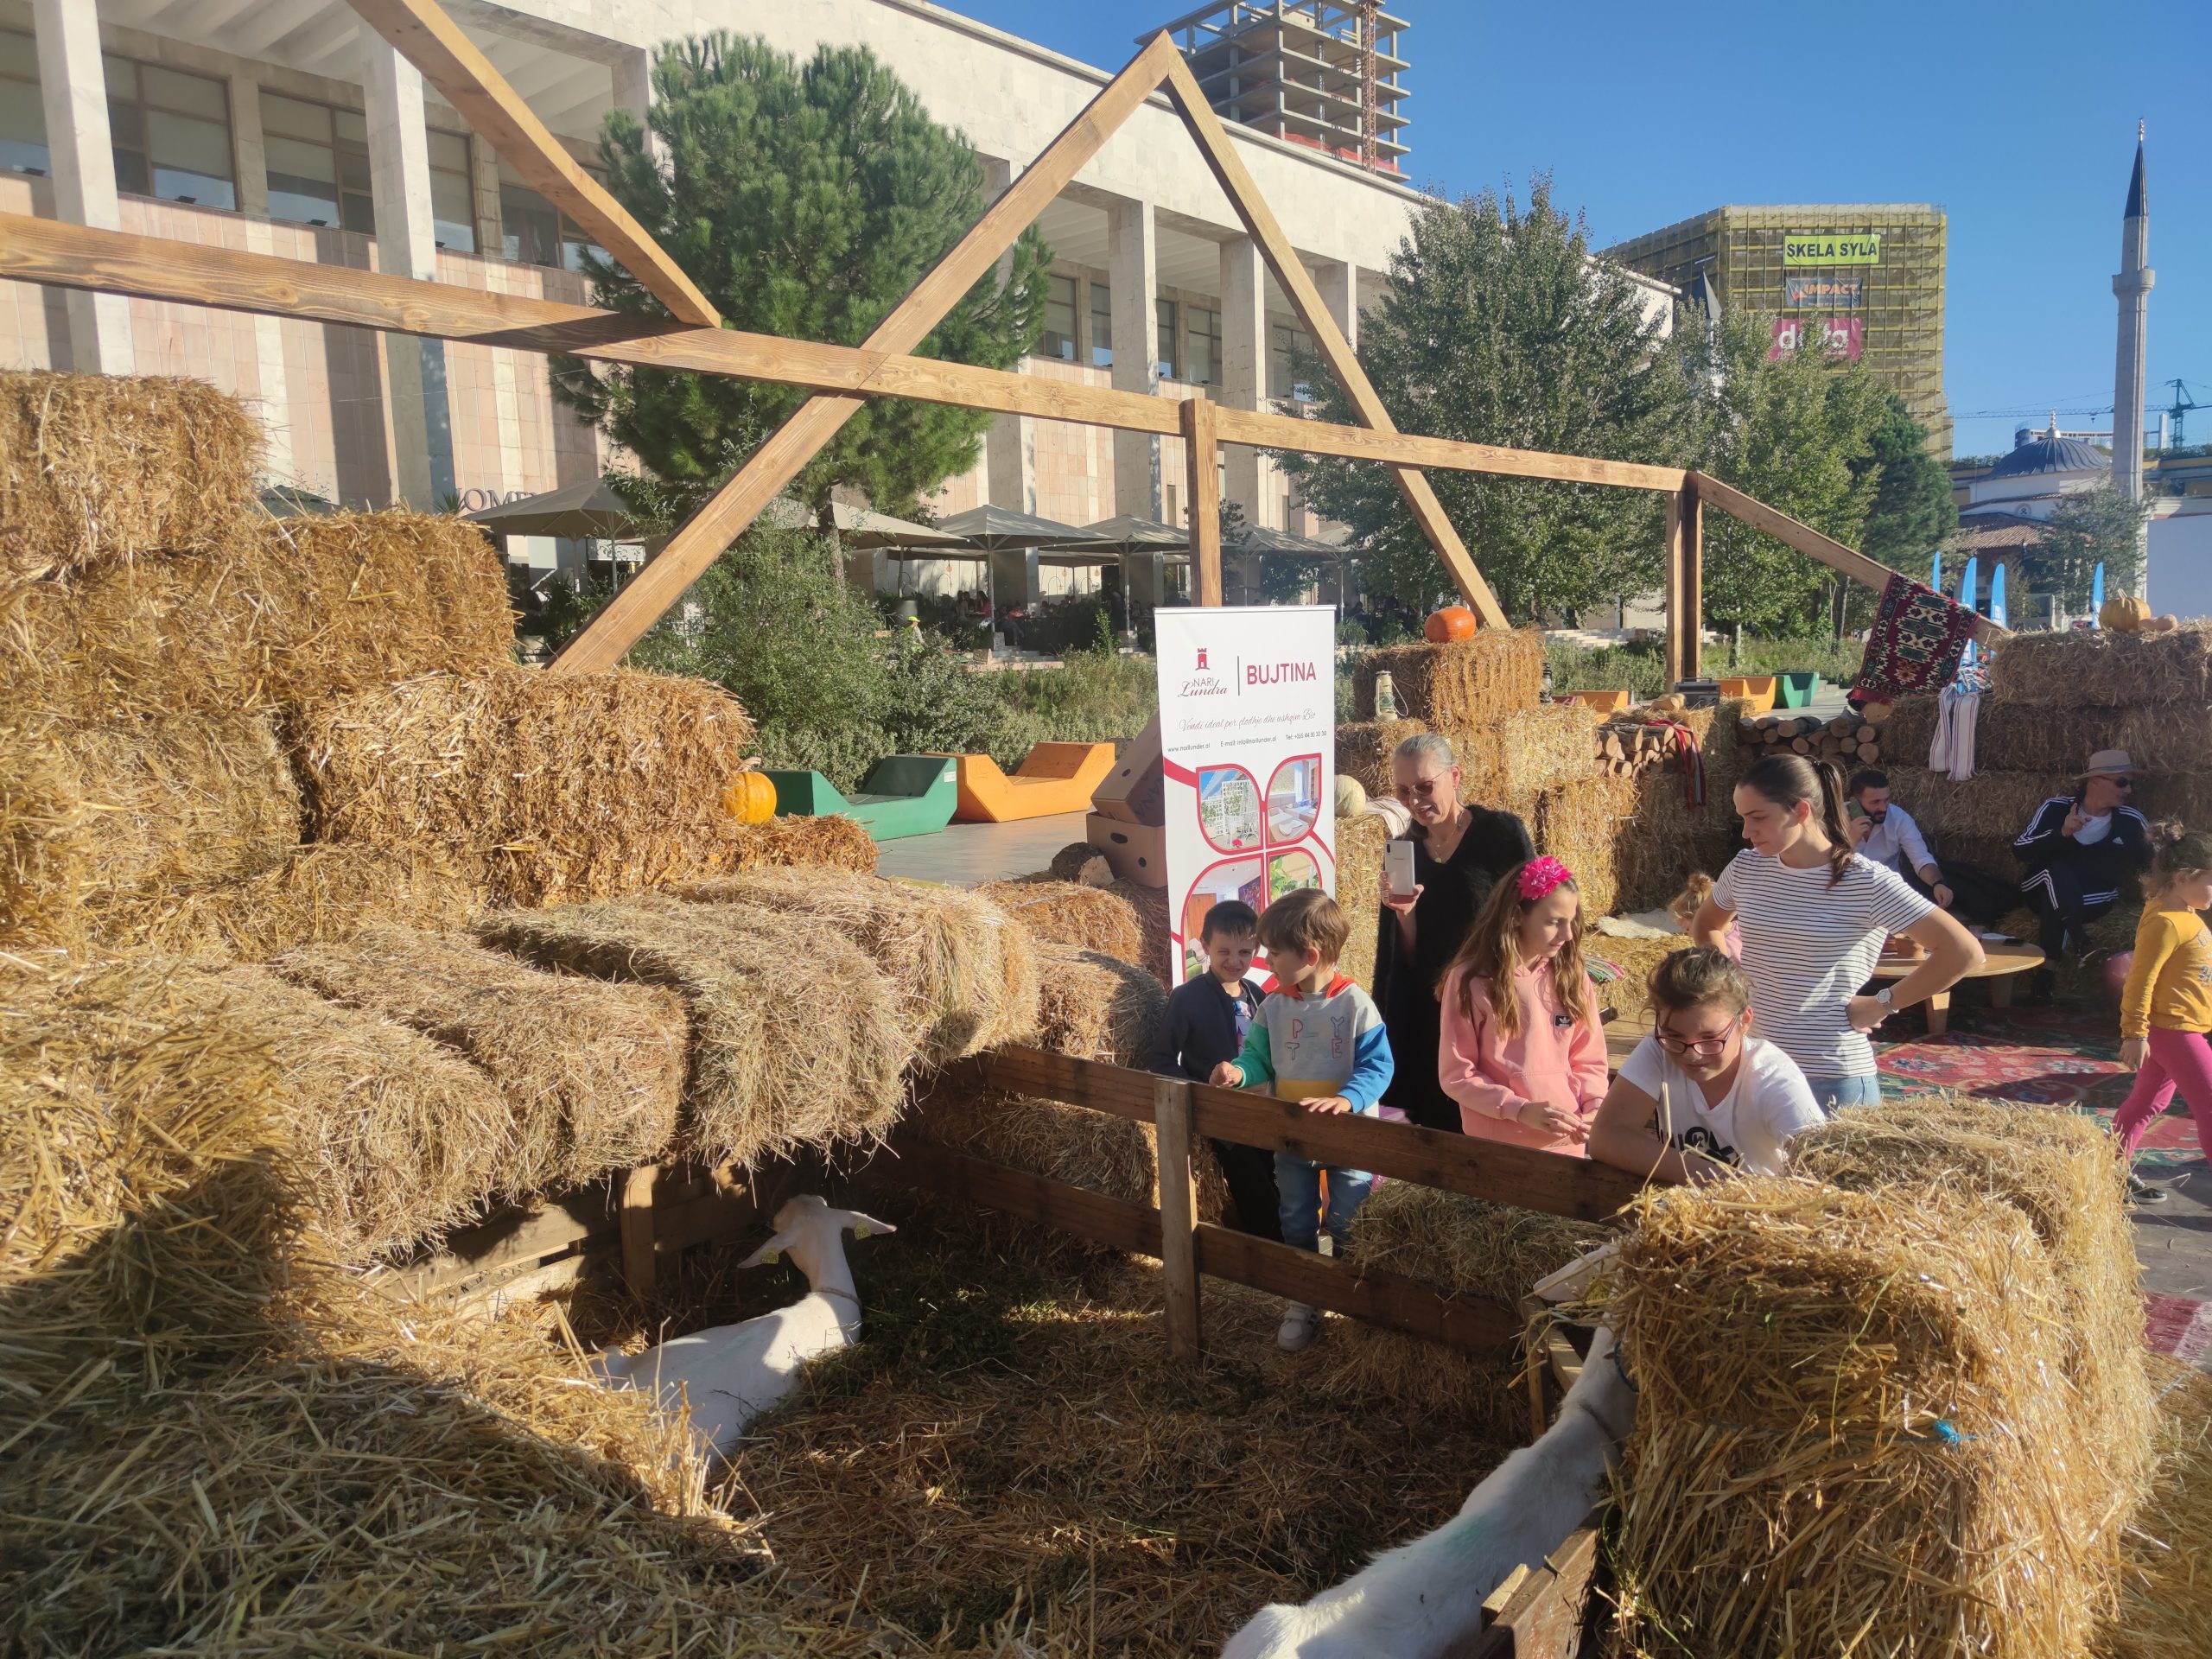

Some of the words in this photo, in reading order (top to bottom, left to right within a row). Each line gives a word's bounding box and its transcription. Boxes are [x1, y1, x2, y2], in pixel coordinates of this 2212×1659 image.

[1787, 243, 1834, 257] SKELA
[1840, 242, 1877, 256] SYLA
[1803, 283, 1858, 295] IMPACT
[1247, 662, 1317, 685] BUJTINA
[1177, 679, 1228, 698] Lundra
[1193, 677, 1214, 688] NARI
